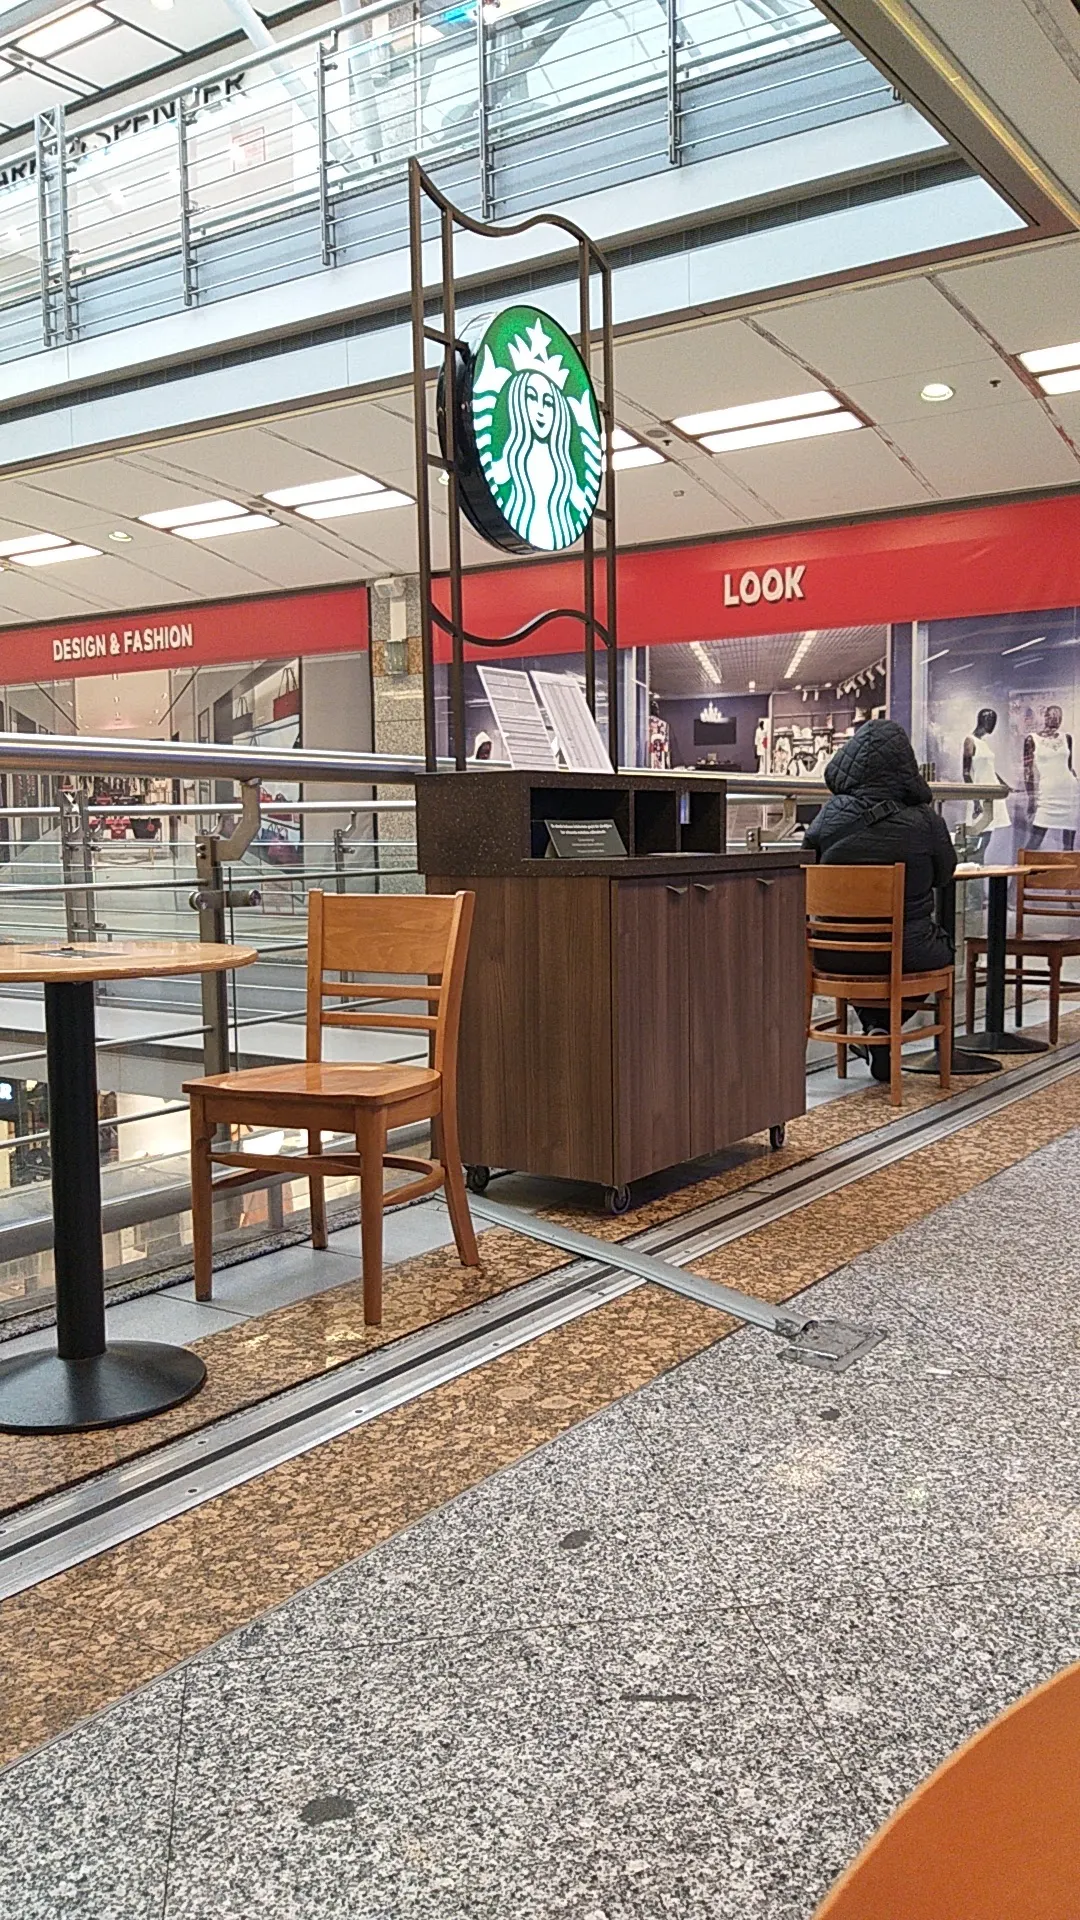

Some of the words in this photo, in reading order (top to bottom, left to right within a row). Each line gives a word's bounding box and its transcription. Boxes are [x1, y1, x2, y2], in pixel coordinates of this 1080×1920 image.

[724, 565, 806, 606] LOOK
[52, 633, 106, 661] DESIGN
[110, 632, 120, 655] &
[123, 623, 193, 654] FASHION
